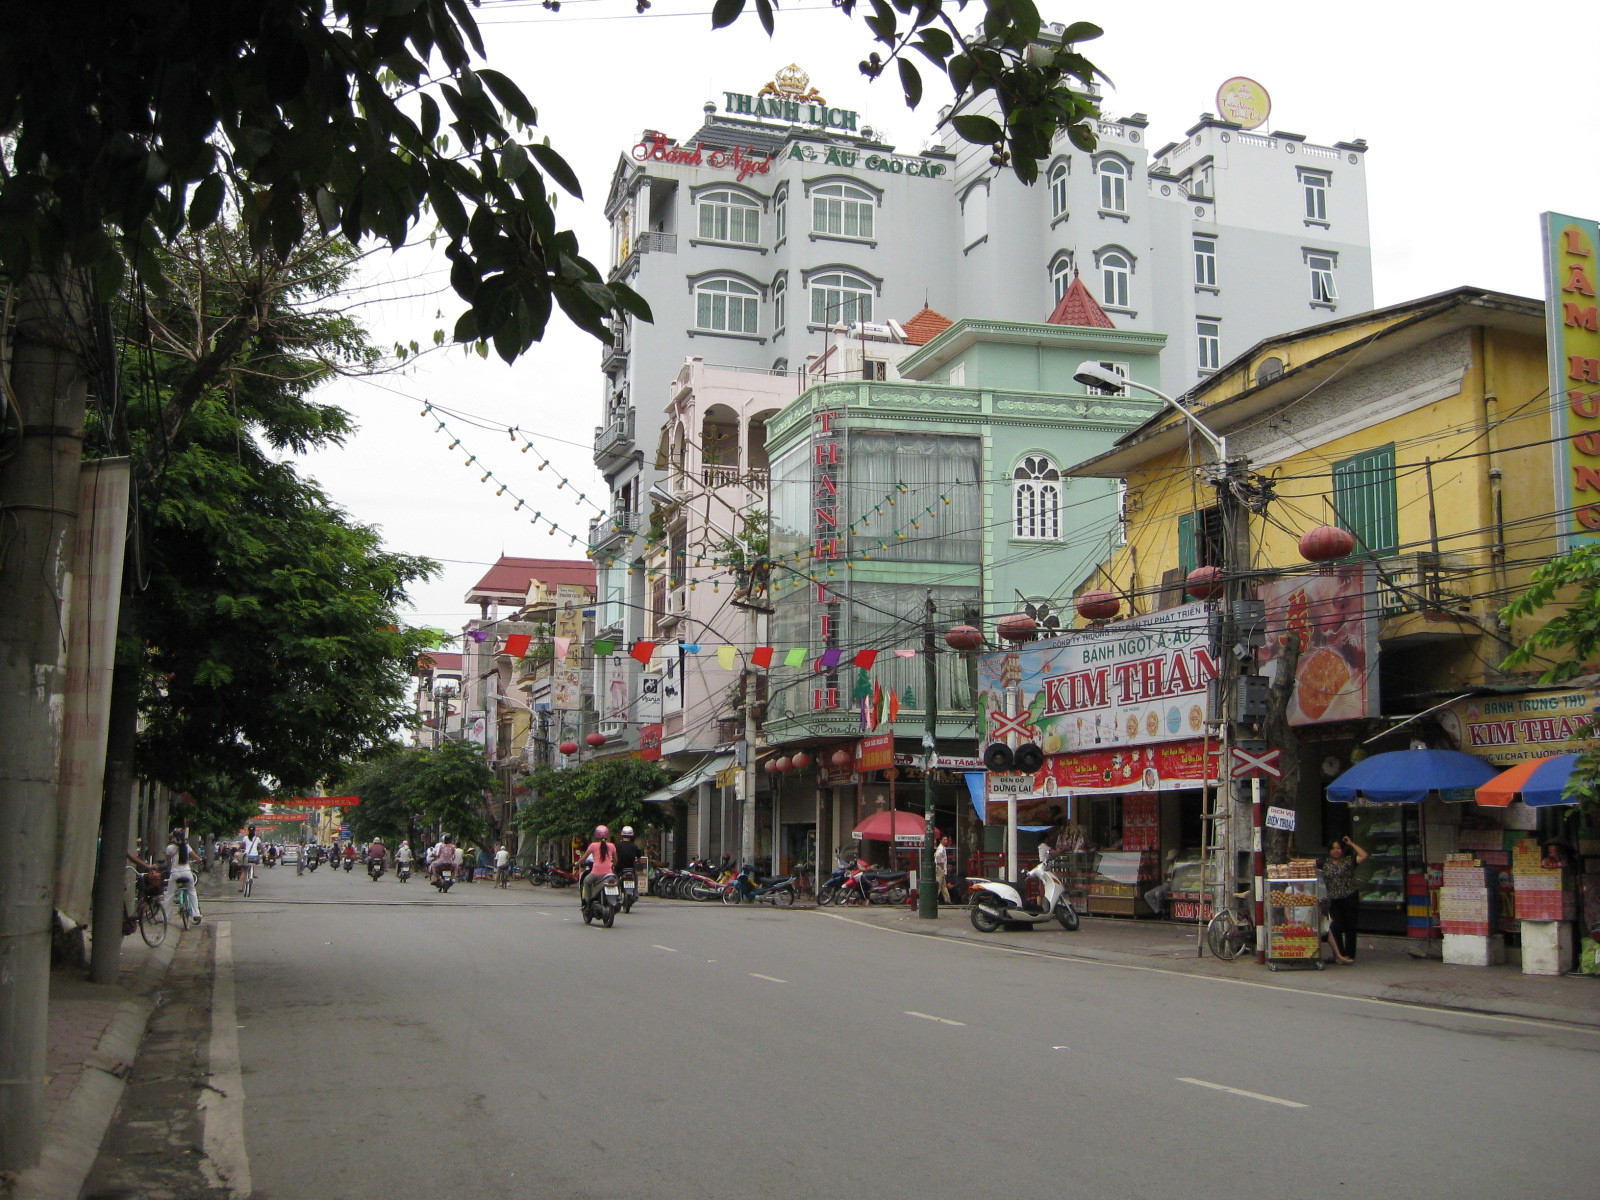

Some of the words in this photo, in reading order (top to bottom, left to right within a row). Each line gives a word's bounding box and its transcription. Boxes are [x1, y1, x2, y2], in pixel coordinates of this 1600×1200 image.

[723, 91, 800, 122] THANH
[864, 154, 904, 174] CAO
[814, 411, 840, 560] THANH
[1082, 641, 1115, 664] BÁNH
[1118, 634, 1154, 656] NGỌT
[1043, 665, 1110, 718] KIM
[1113, 645, 1220, 706] THAN
[1484, 699, 1514, 715] BÁNH
[1518, 696, 1559, 712] TRUNG
[1562, 694, 1586, 708] THU
[1467, 721, 1519, 747] KIM
[1520, 714, 1600, 744] THAN
[1018, 784, 1031, 794] LẠI
[1175, 902, 1194, 918] KIM
